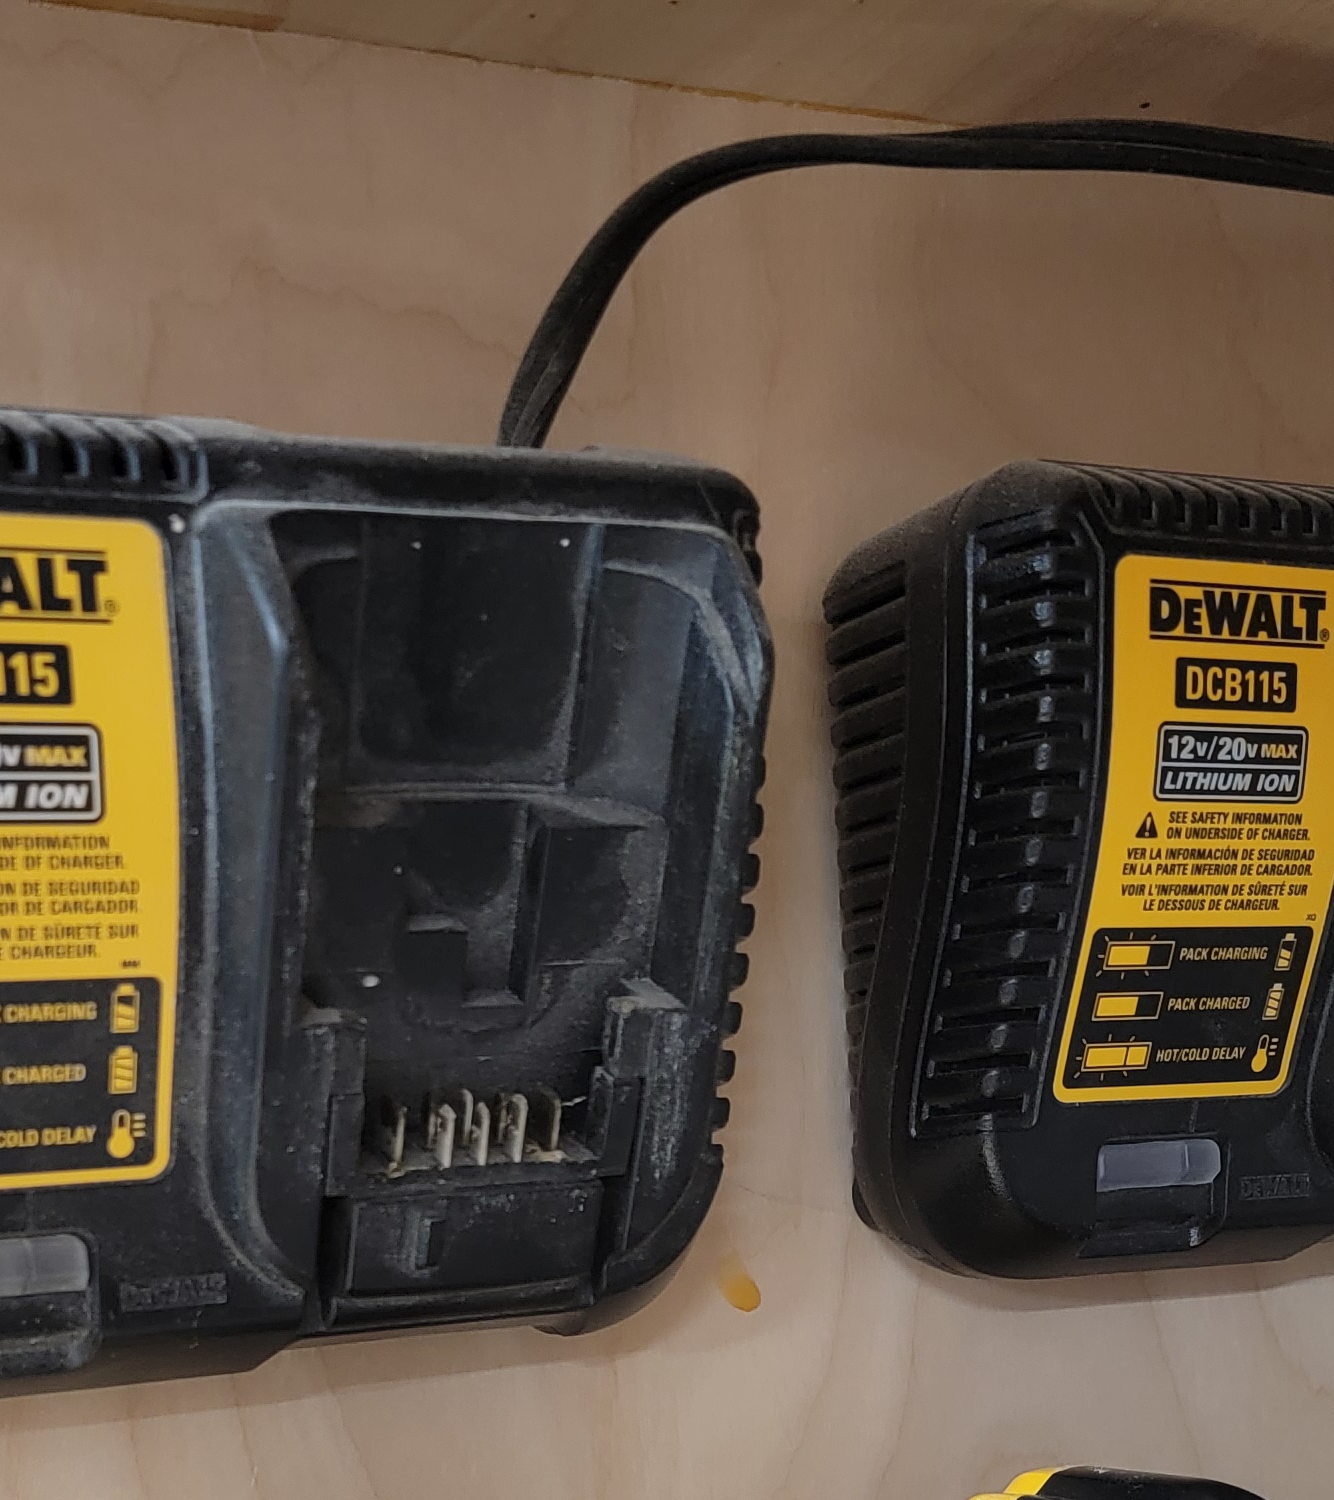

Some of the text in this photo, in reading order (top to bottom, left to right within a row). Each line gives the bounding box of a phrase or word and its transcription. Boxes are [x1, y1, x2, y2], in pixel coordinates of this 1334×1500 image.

[1186, 666, 1287, 704] DCB115
[25, 746, 86, 767] MAX
[1261, 743, 1298, 759] MAX
[1164, 772, 1296, 792] LITHIUM ION
[25, 783, 88, 808] ION
[1169, 811, 1303, 825] SEE SAFETY INFORMATION
[1166, 827, 1310, 840] ON UNDERSIDE OF CHARGER.
[1126, 846, 1315, 861] VER LA INFORMACIÓN DE SEGURIDAD
[16, 855, 42, 870] OF
[1122, 863, 1314, 876] EN LA PARTE INFERIOR DE CARGADOR.
[22, 881, 42, 897] DE
[48, 880, 140, 896] SEGURIDAD
[1121, 880, 1308, 896] VOIR L'INFORMATION DE SÛRETÉ SUR
[24, 902, 44, 916] DE
[1143, 898, 1280, 911] LE DESSOUS DE CHARGEUR.
[17, 926, 38, 941] DE
[107, 923, 140, 939] SUR
[1179, 947, 1268, 961] PACK CHARGING
[1167, 996, 1250, 1011] PACK CHARGED
[6, 1002, 98, 1023] CHARGING
[1156, 1045, 1246, 1062] HOT/COLD DELAY
[6, 1063, 86, 1084] CHARGED
[42, 1127, 96, 1148] DELAY
